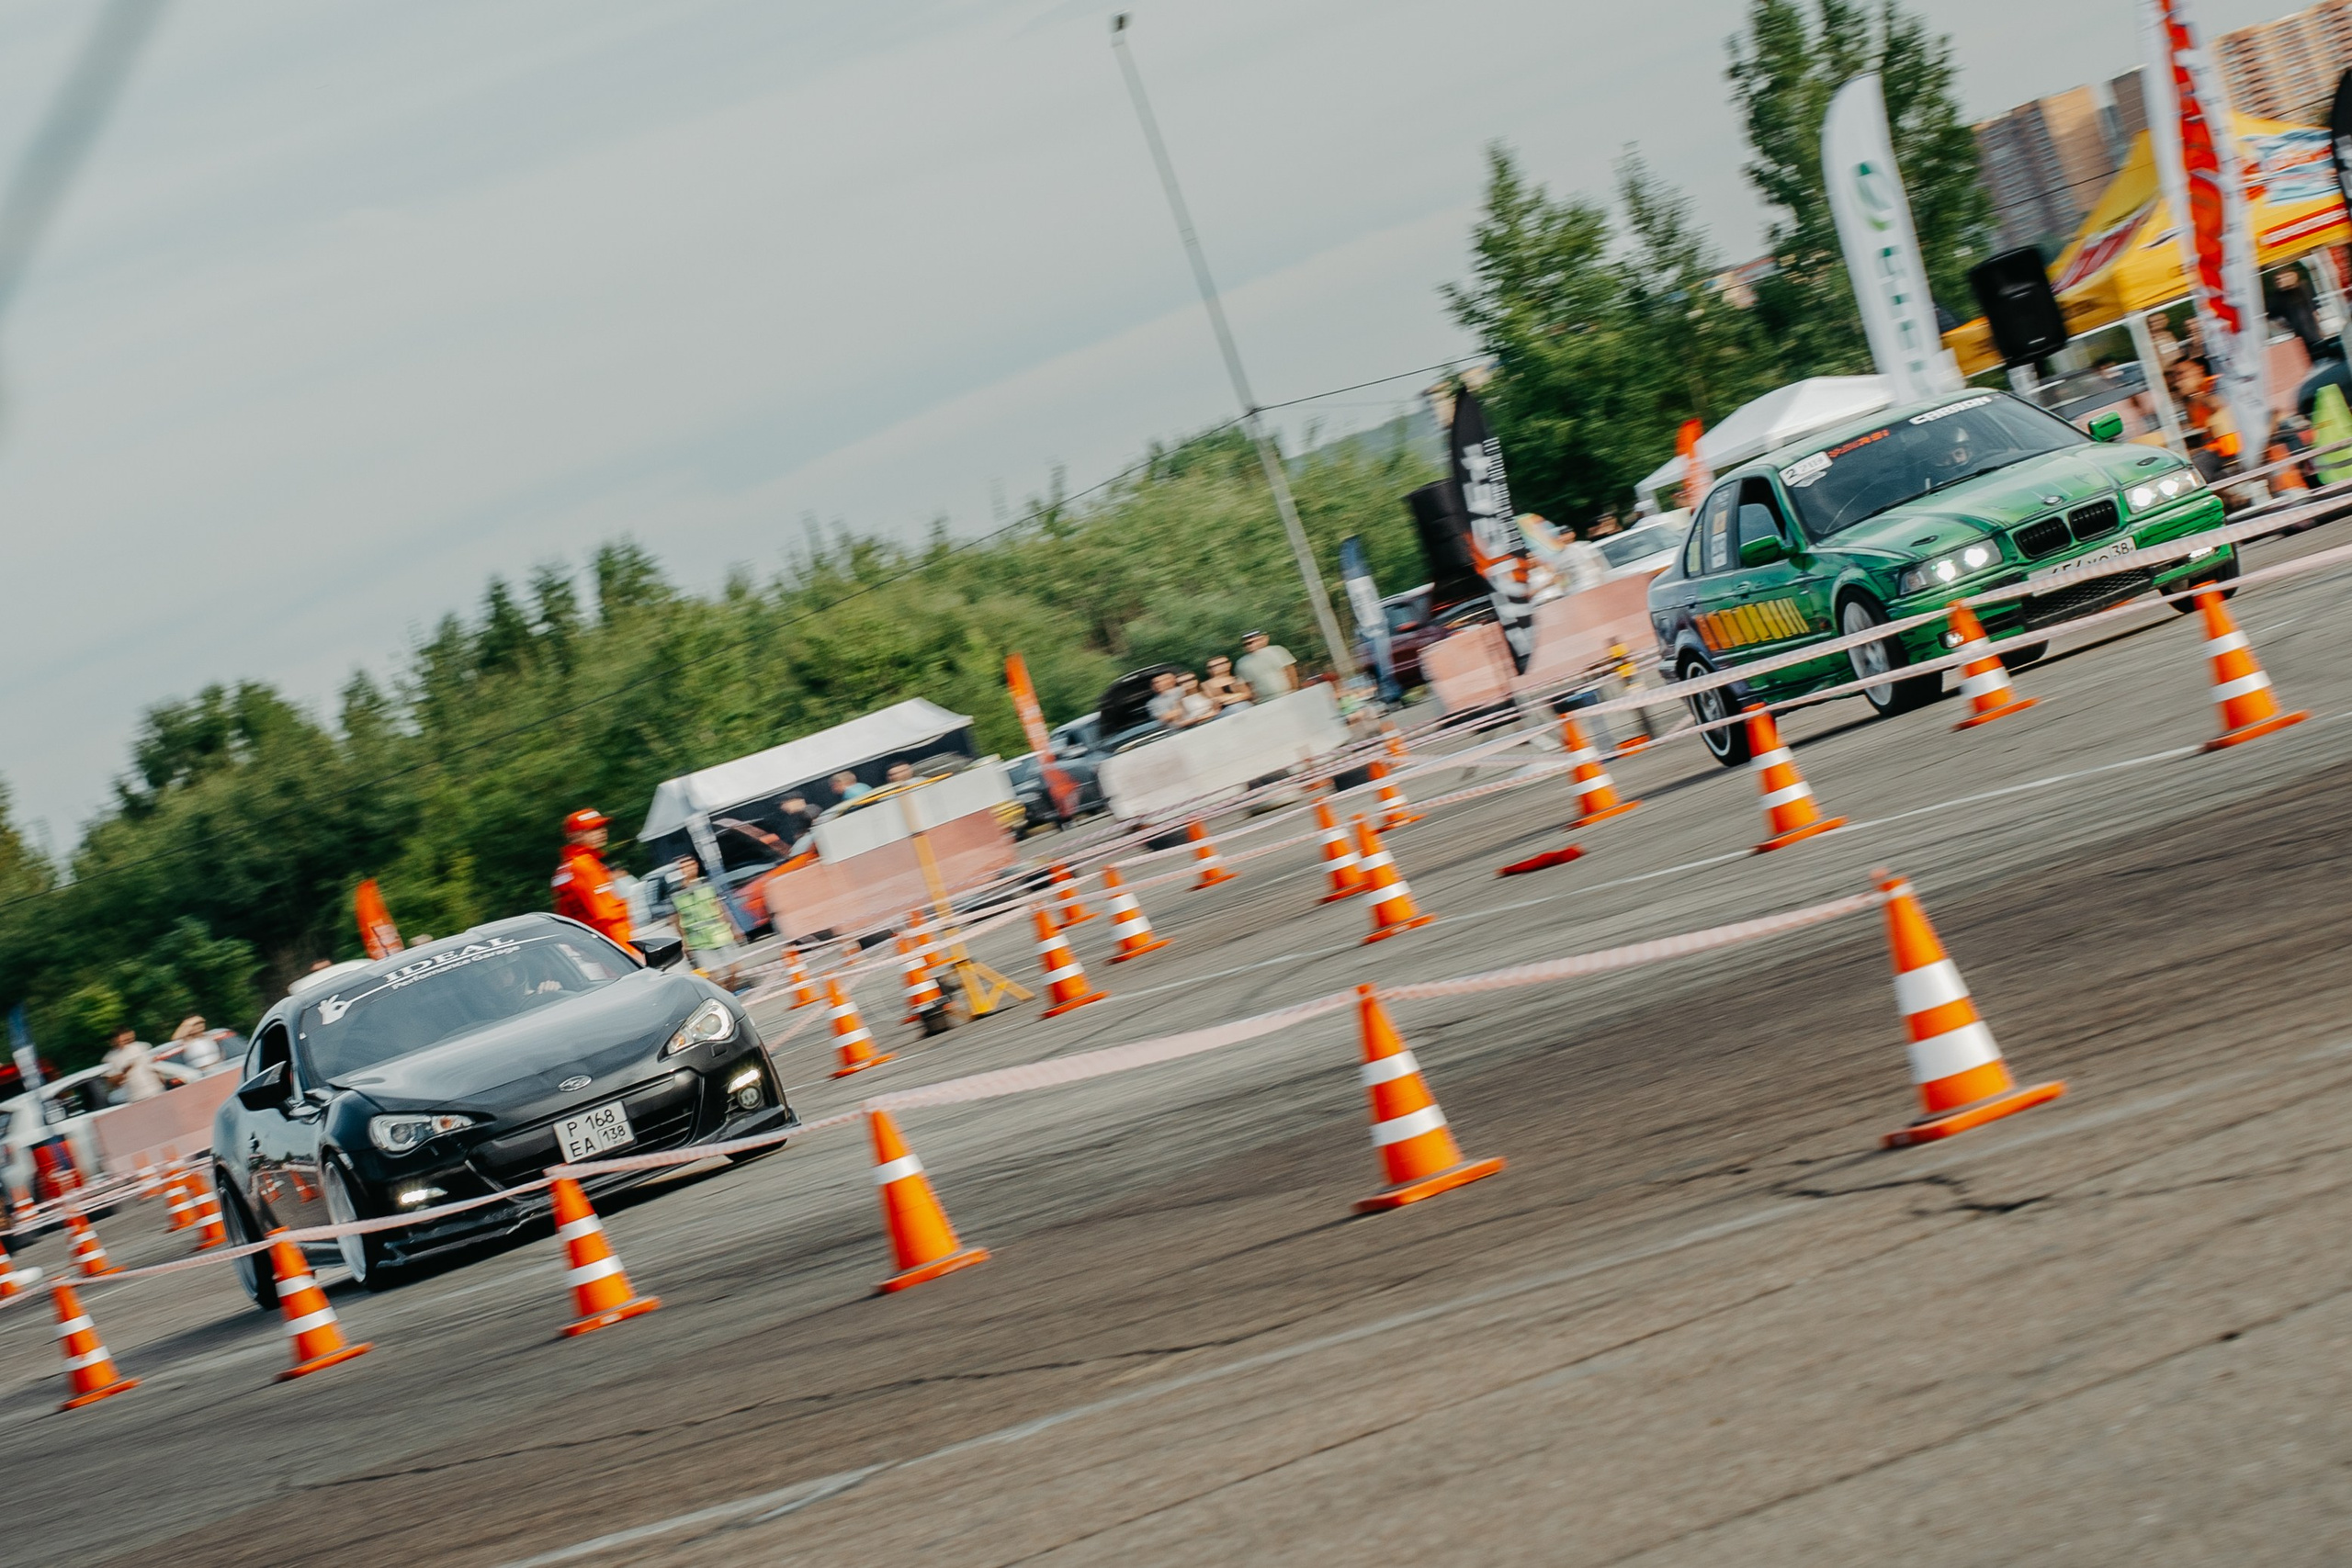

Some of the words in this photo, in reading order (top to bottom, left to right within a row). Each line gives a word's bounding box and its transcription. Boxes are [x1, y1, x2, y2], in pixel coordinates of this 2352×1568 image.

[2111, 542, 2130, 557] 38
[382, 937, 515, 983] IDEAL
[470, 945, 521, 963] Garage
[585, 1109, 615, 1129] 168
[603, 1125, 626, 1141] 138
